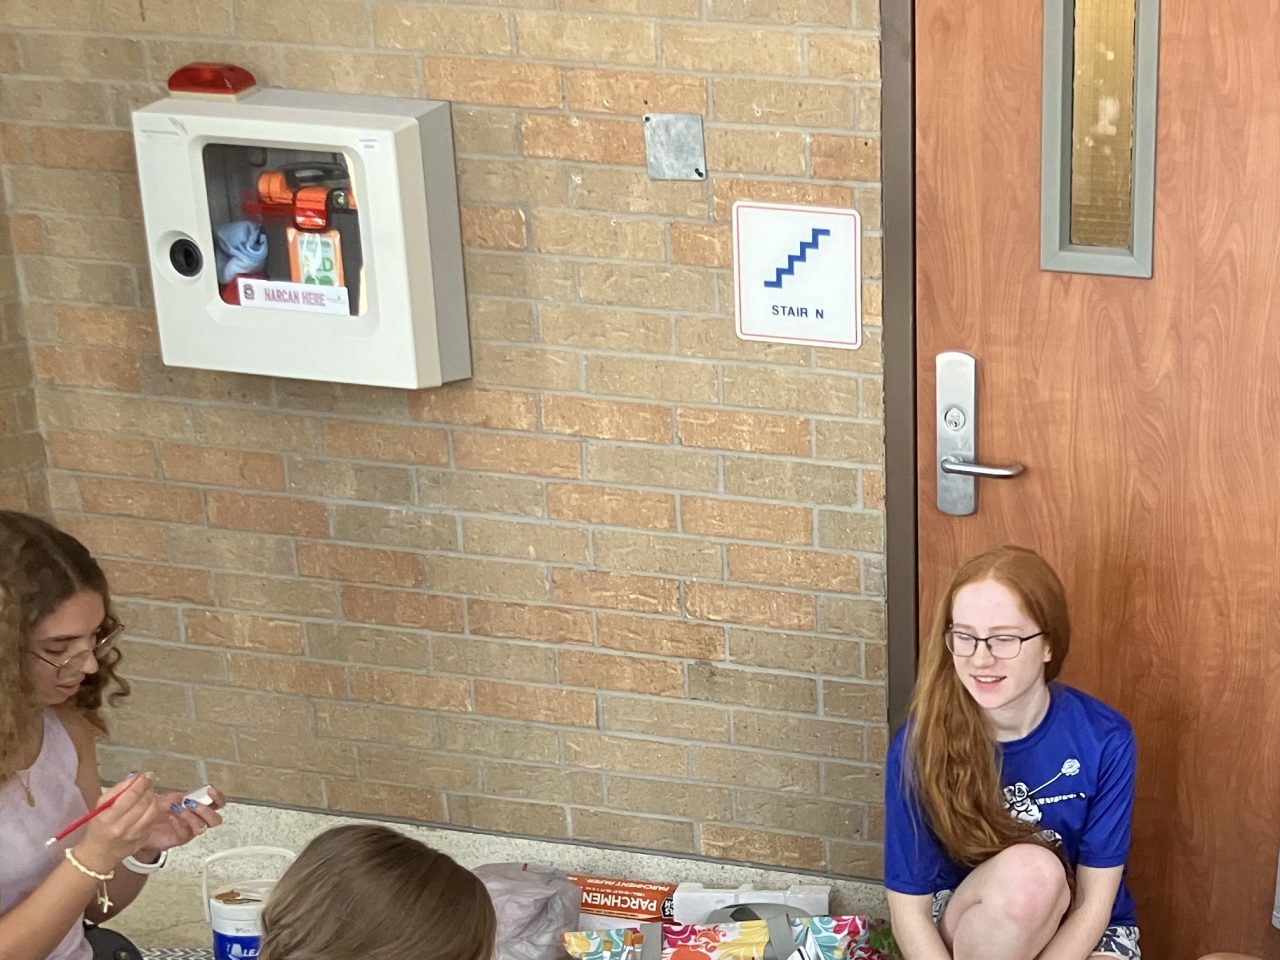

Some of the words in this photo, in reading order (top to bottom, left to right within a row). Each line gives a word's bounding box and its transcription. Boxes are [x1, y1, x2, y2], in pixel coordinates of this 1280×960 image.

[264, 288, 300, 305] NARCAN
[302, 290, 326, 306] HERE
[771, 304, 809, 318] STAIR
[815, 308, 824, 320] N
[582, 891, 657, 912] PARCHMEN
